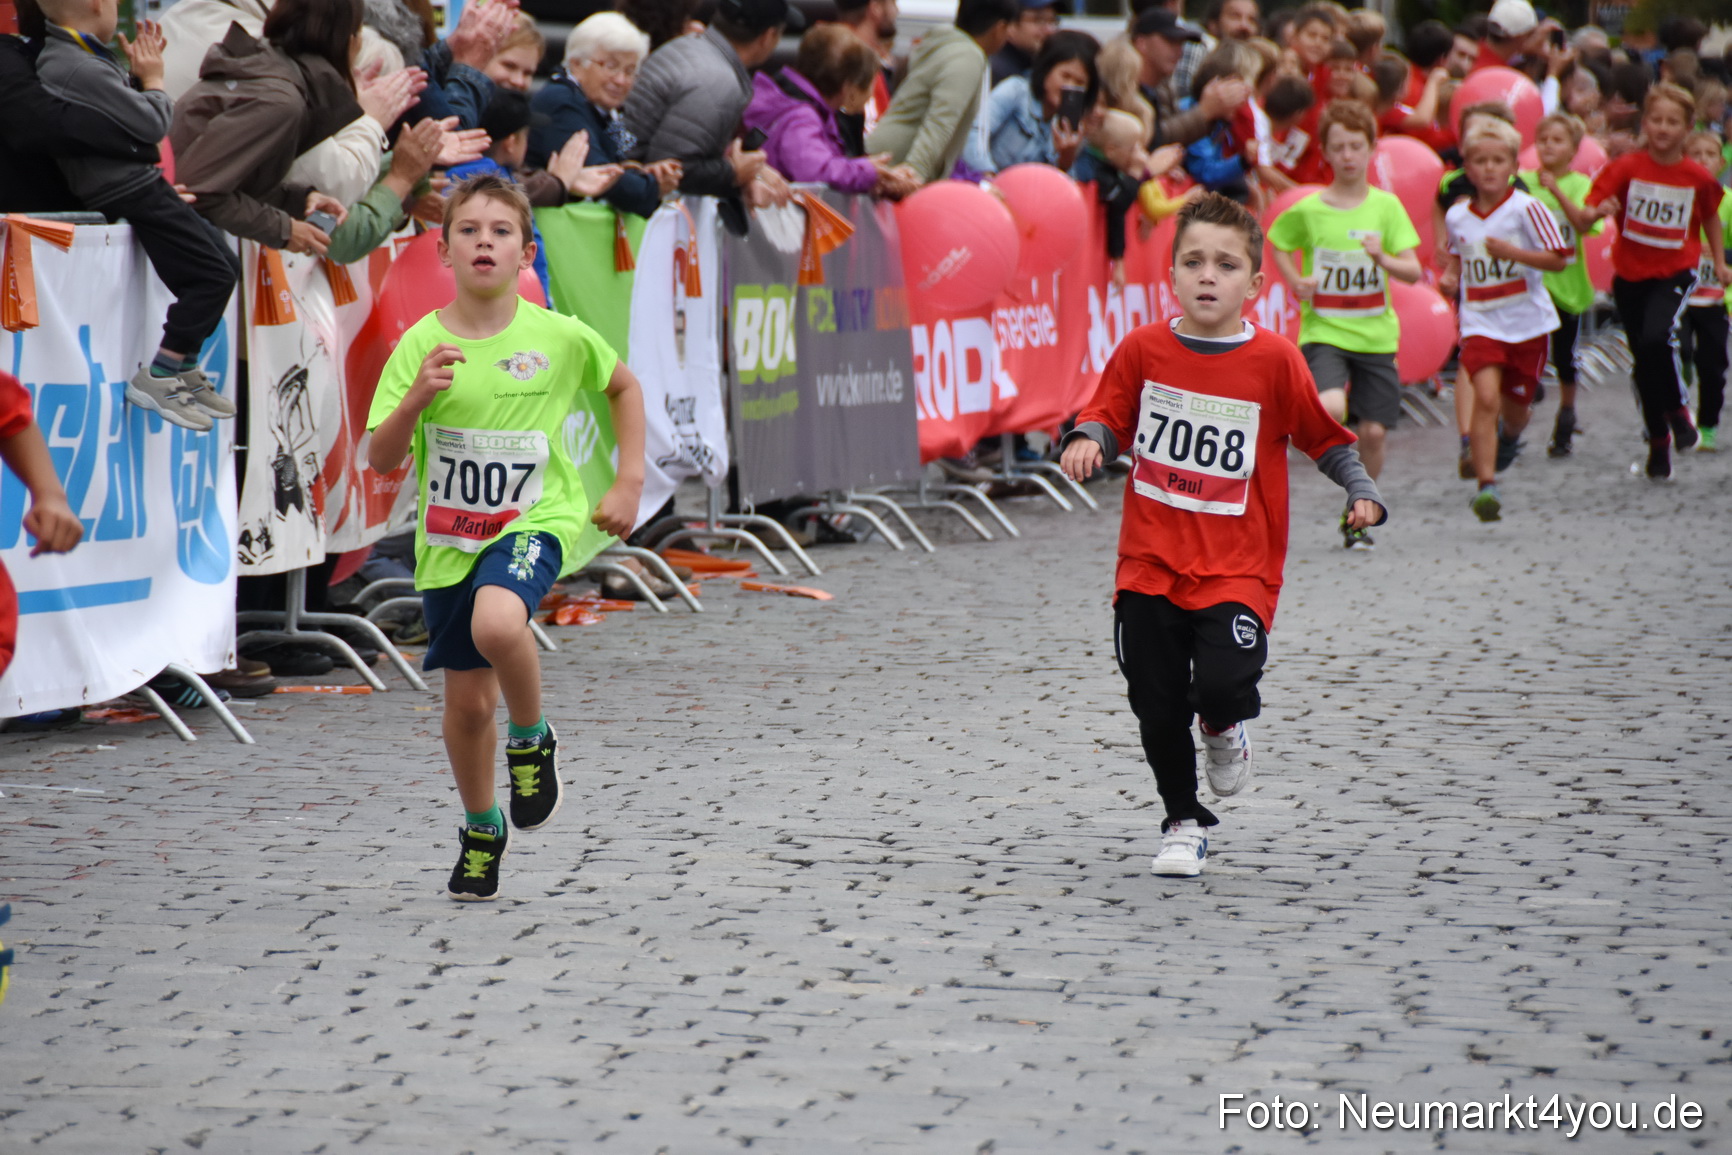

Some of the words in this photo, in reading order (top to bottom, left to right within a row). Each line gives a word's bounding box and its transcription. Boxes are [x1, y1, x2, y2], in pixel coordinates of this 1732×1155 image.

[1633, 196, 1685, 224] 7051
[1321, 260, 1379, 291] 7044
[1190, 396, 1252, 420] BOCK
[472, 434, 538, 451] BOCK
[1148, 411, 1246, 473] 7068
[439, 455, 537, 508] 7007
[1167, 472, 1203, 495] Paul
